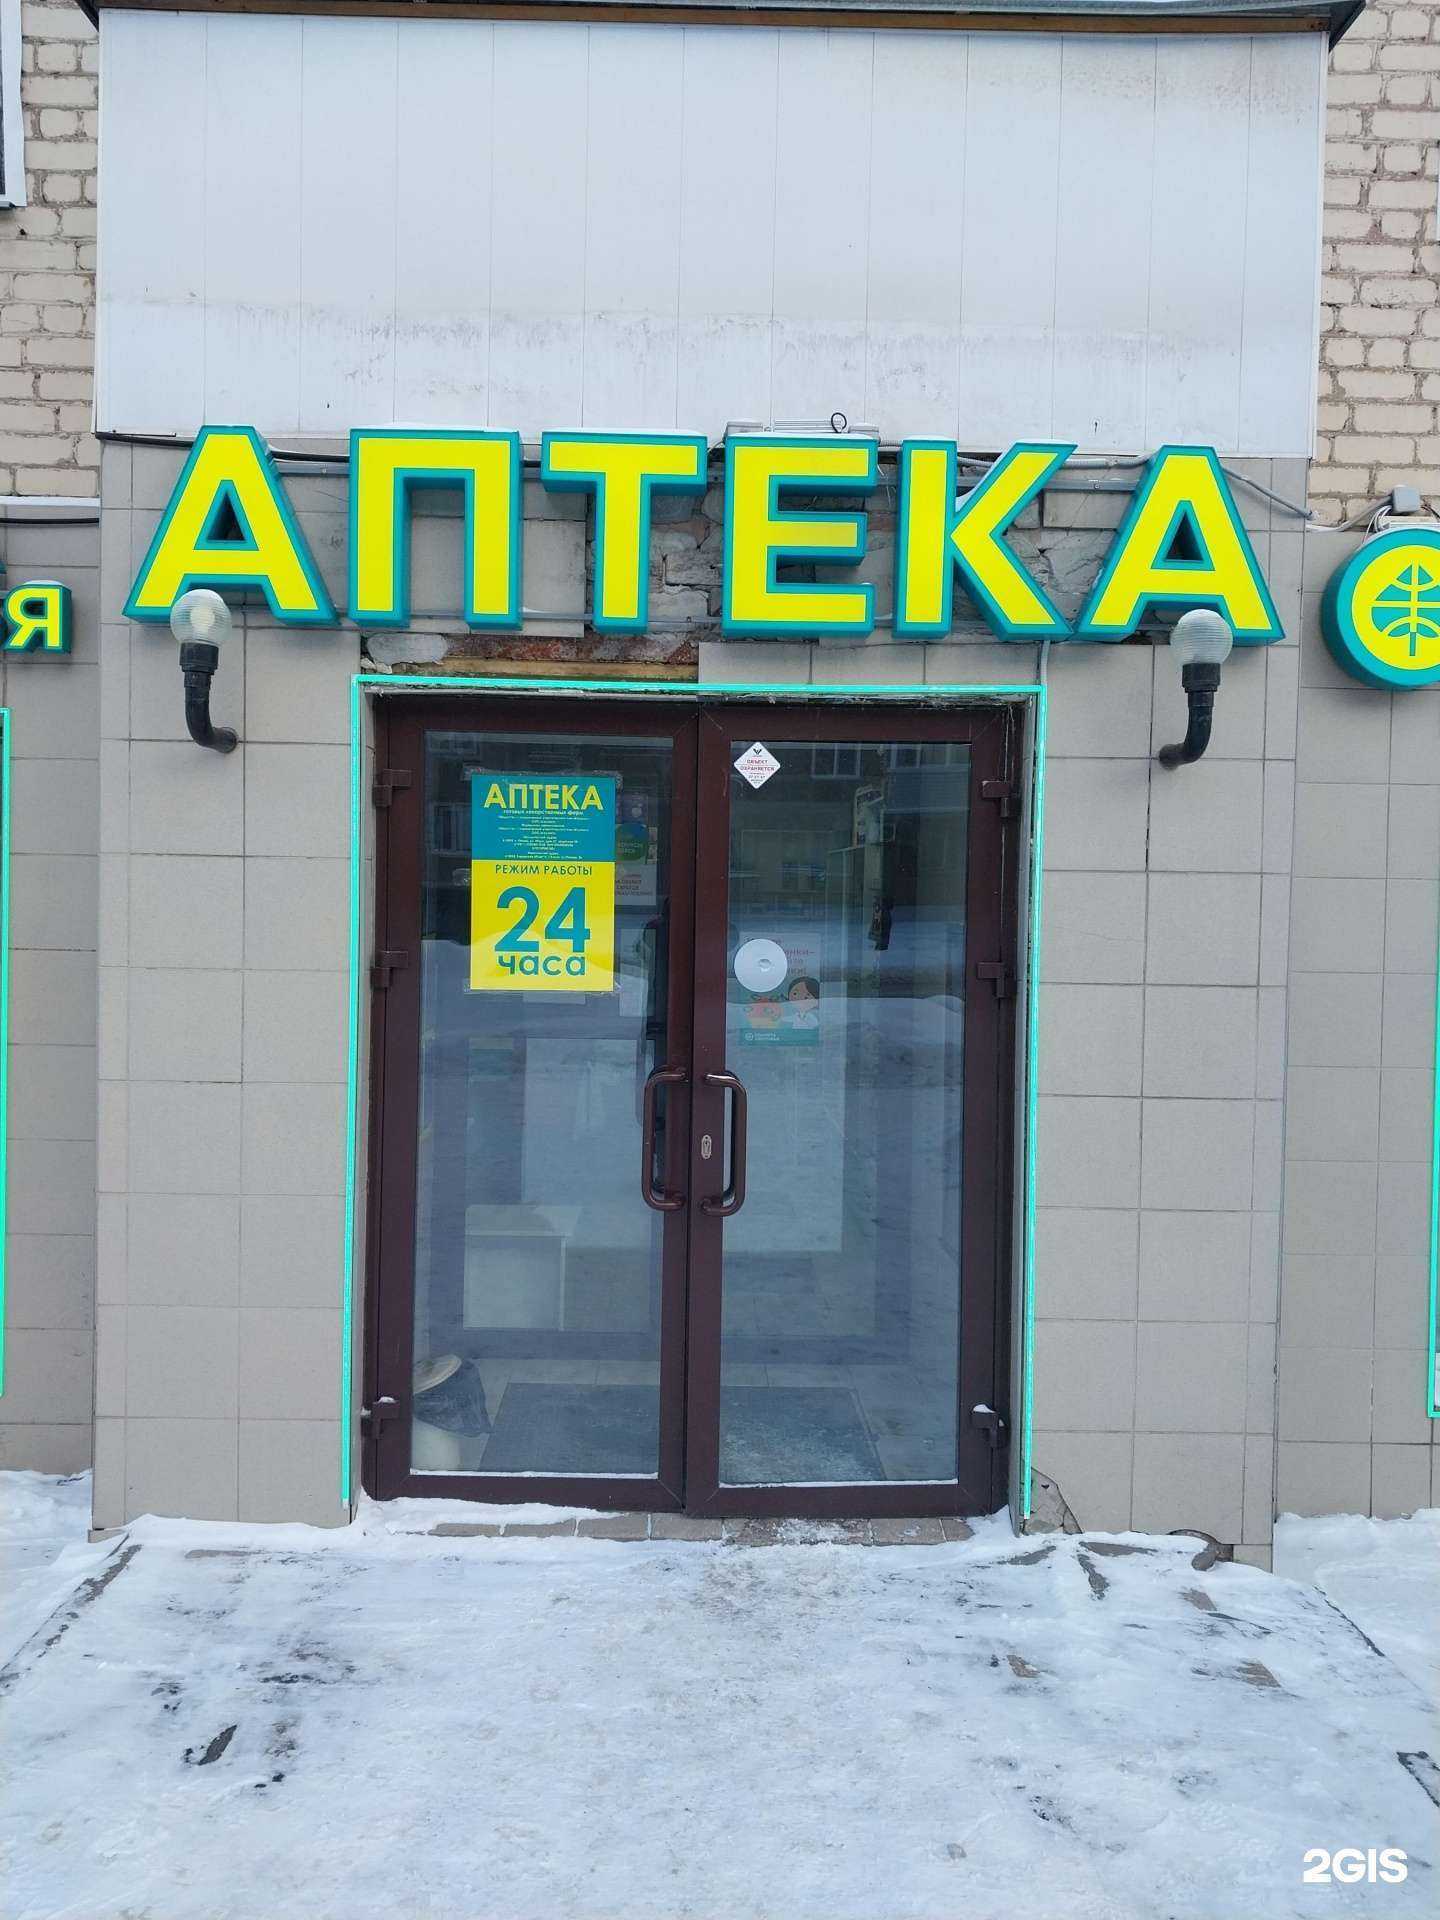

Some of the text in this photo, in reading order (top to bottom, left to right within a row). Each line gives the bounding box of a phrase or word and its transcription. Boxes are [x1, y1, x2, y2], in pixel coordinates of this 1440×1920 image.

[124, 424, 1284, 642] АПТЕКА
[484, 783, 604, 811] АПТЕКА
[495, 864, 592, 876] РЕЖИМ РАБОТЫ
[494, 886, 591, 953] 24
[498, 954, 586, 976] часа
